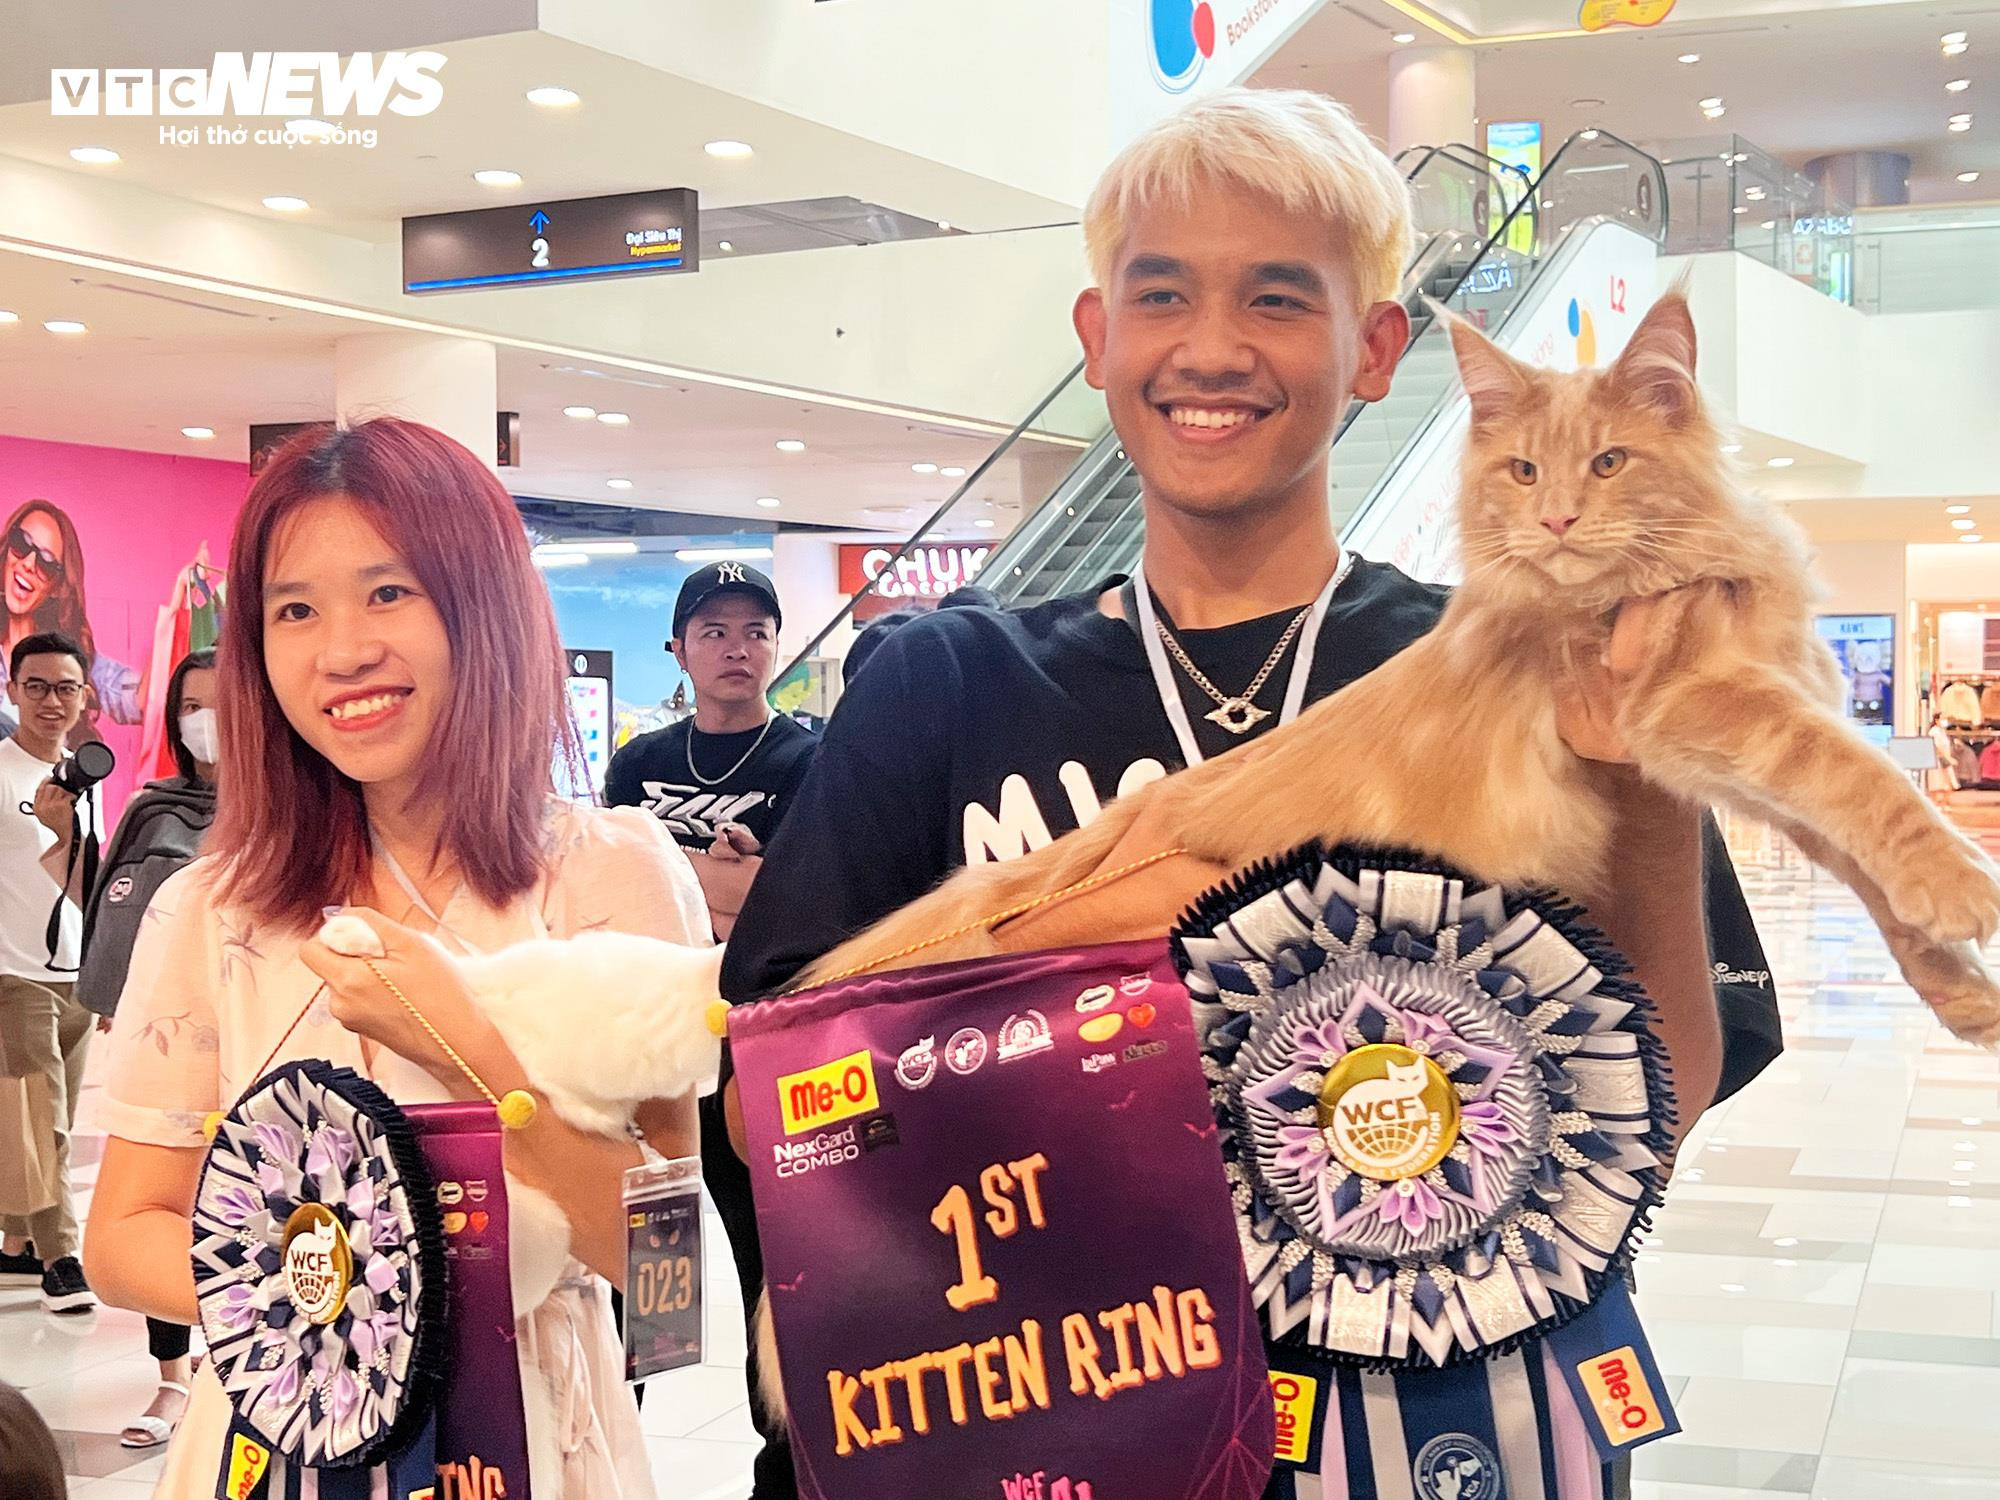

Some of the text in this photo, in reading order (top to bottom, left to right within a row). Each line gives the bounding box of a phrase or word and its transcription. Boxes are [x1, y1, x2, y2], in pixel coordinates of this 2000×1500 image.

[530, 238, 550, 268] 2
[1611, 275, 1626, 313] L2
[1340, 1096, 1417, 1126] WCF
[773, 1125, 856, 1163] NexGard
[776, 1144, 860, 1178] COMBO
[291, 1249, 328, 1272] WCF
[637, 1256, 693, 1317] 023
[827, 1285, 1222, 1457] KITTEN RING
